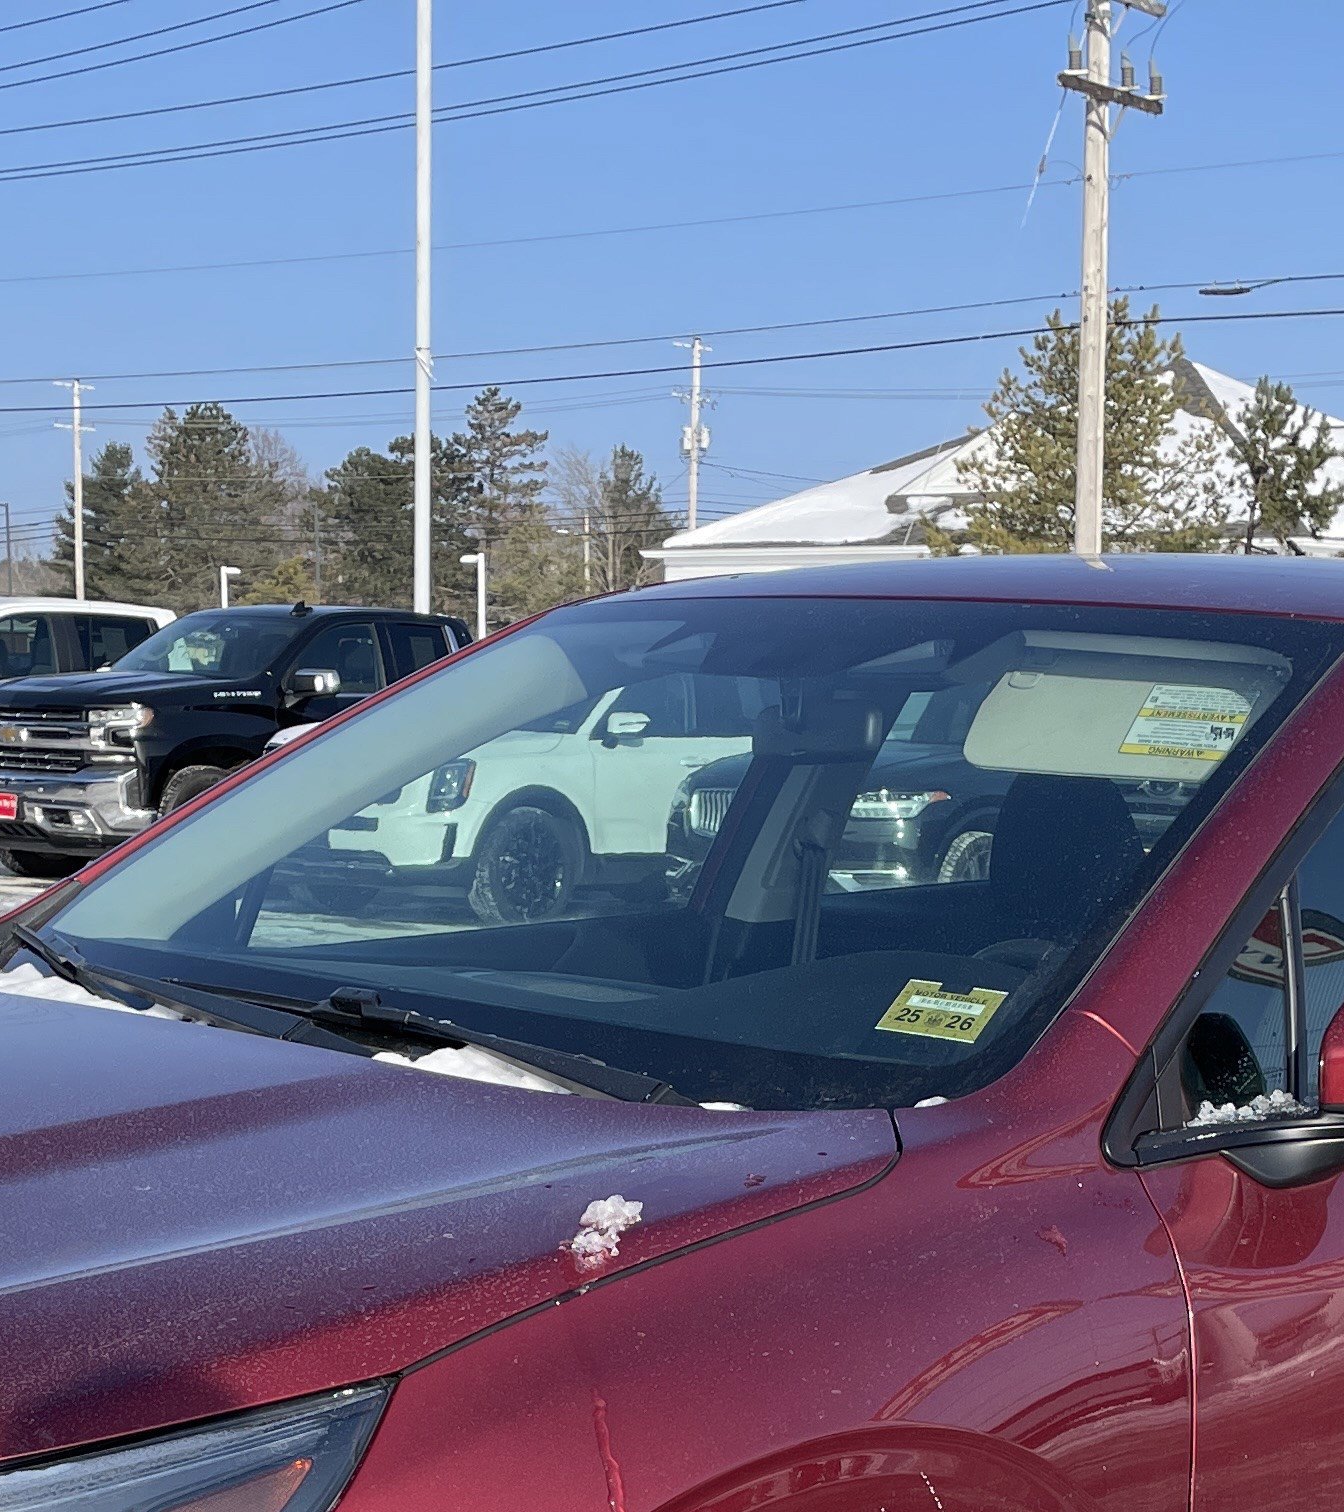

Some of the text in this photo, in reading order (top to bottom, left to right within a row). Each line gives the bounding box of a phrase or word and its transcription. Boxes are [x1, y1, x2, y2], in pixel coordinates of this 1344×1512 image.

[1149, 709, 1226, 722] AVERTISSEMENT
[1148, 747, 1195, 758] WARNING
[915, 989, 948, 999] MOTOR
[950, 994, 988, 1005] VEHICLE
[894, 1007, 976, 1032] 25 26
